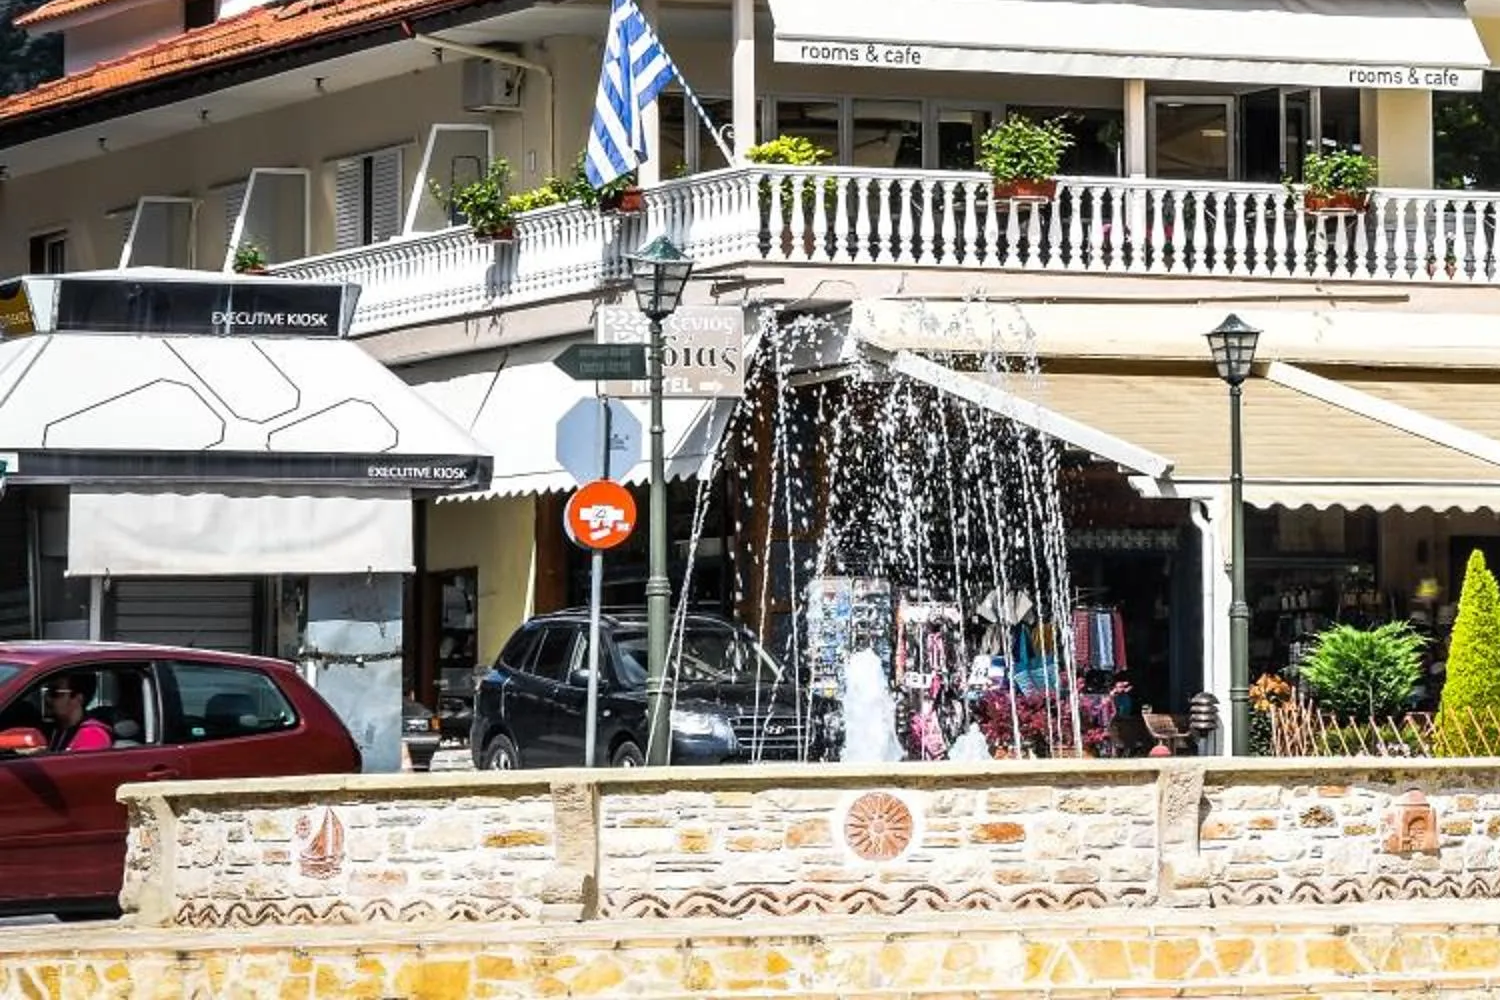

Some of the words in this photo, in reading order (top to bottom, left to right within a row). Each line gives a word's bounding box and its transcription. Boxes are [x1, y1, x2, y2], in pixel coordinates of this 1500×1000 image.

[801, 45, 859, 61] rooms
[865, 44, 879, 63] &
[884, 47, 921, 65] cafe
[1349, 68, 1403, 85] rooms
[1407, 66, 1420, 85] &
[1424, 68, 1460, 87] cafe
[211, 311, 285, 325] EXECUTIVE
[287, 313, 328, 327] KIOSK
[631, 377, 693, 393] HTEL
[367, 466, 432, 479] EXECUTIVE
[433, 467, 468, 480] KIOSK
